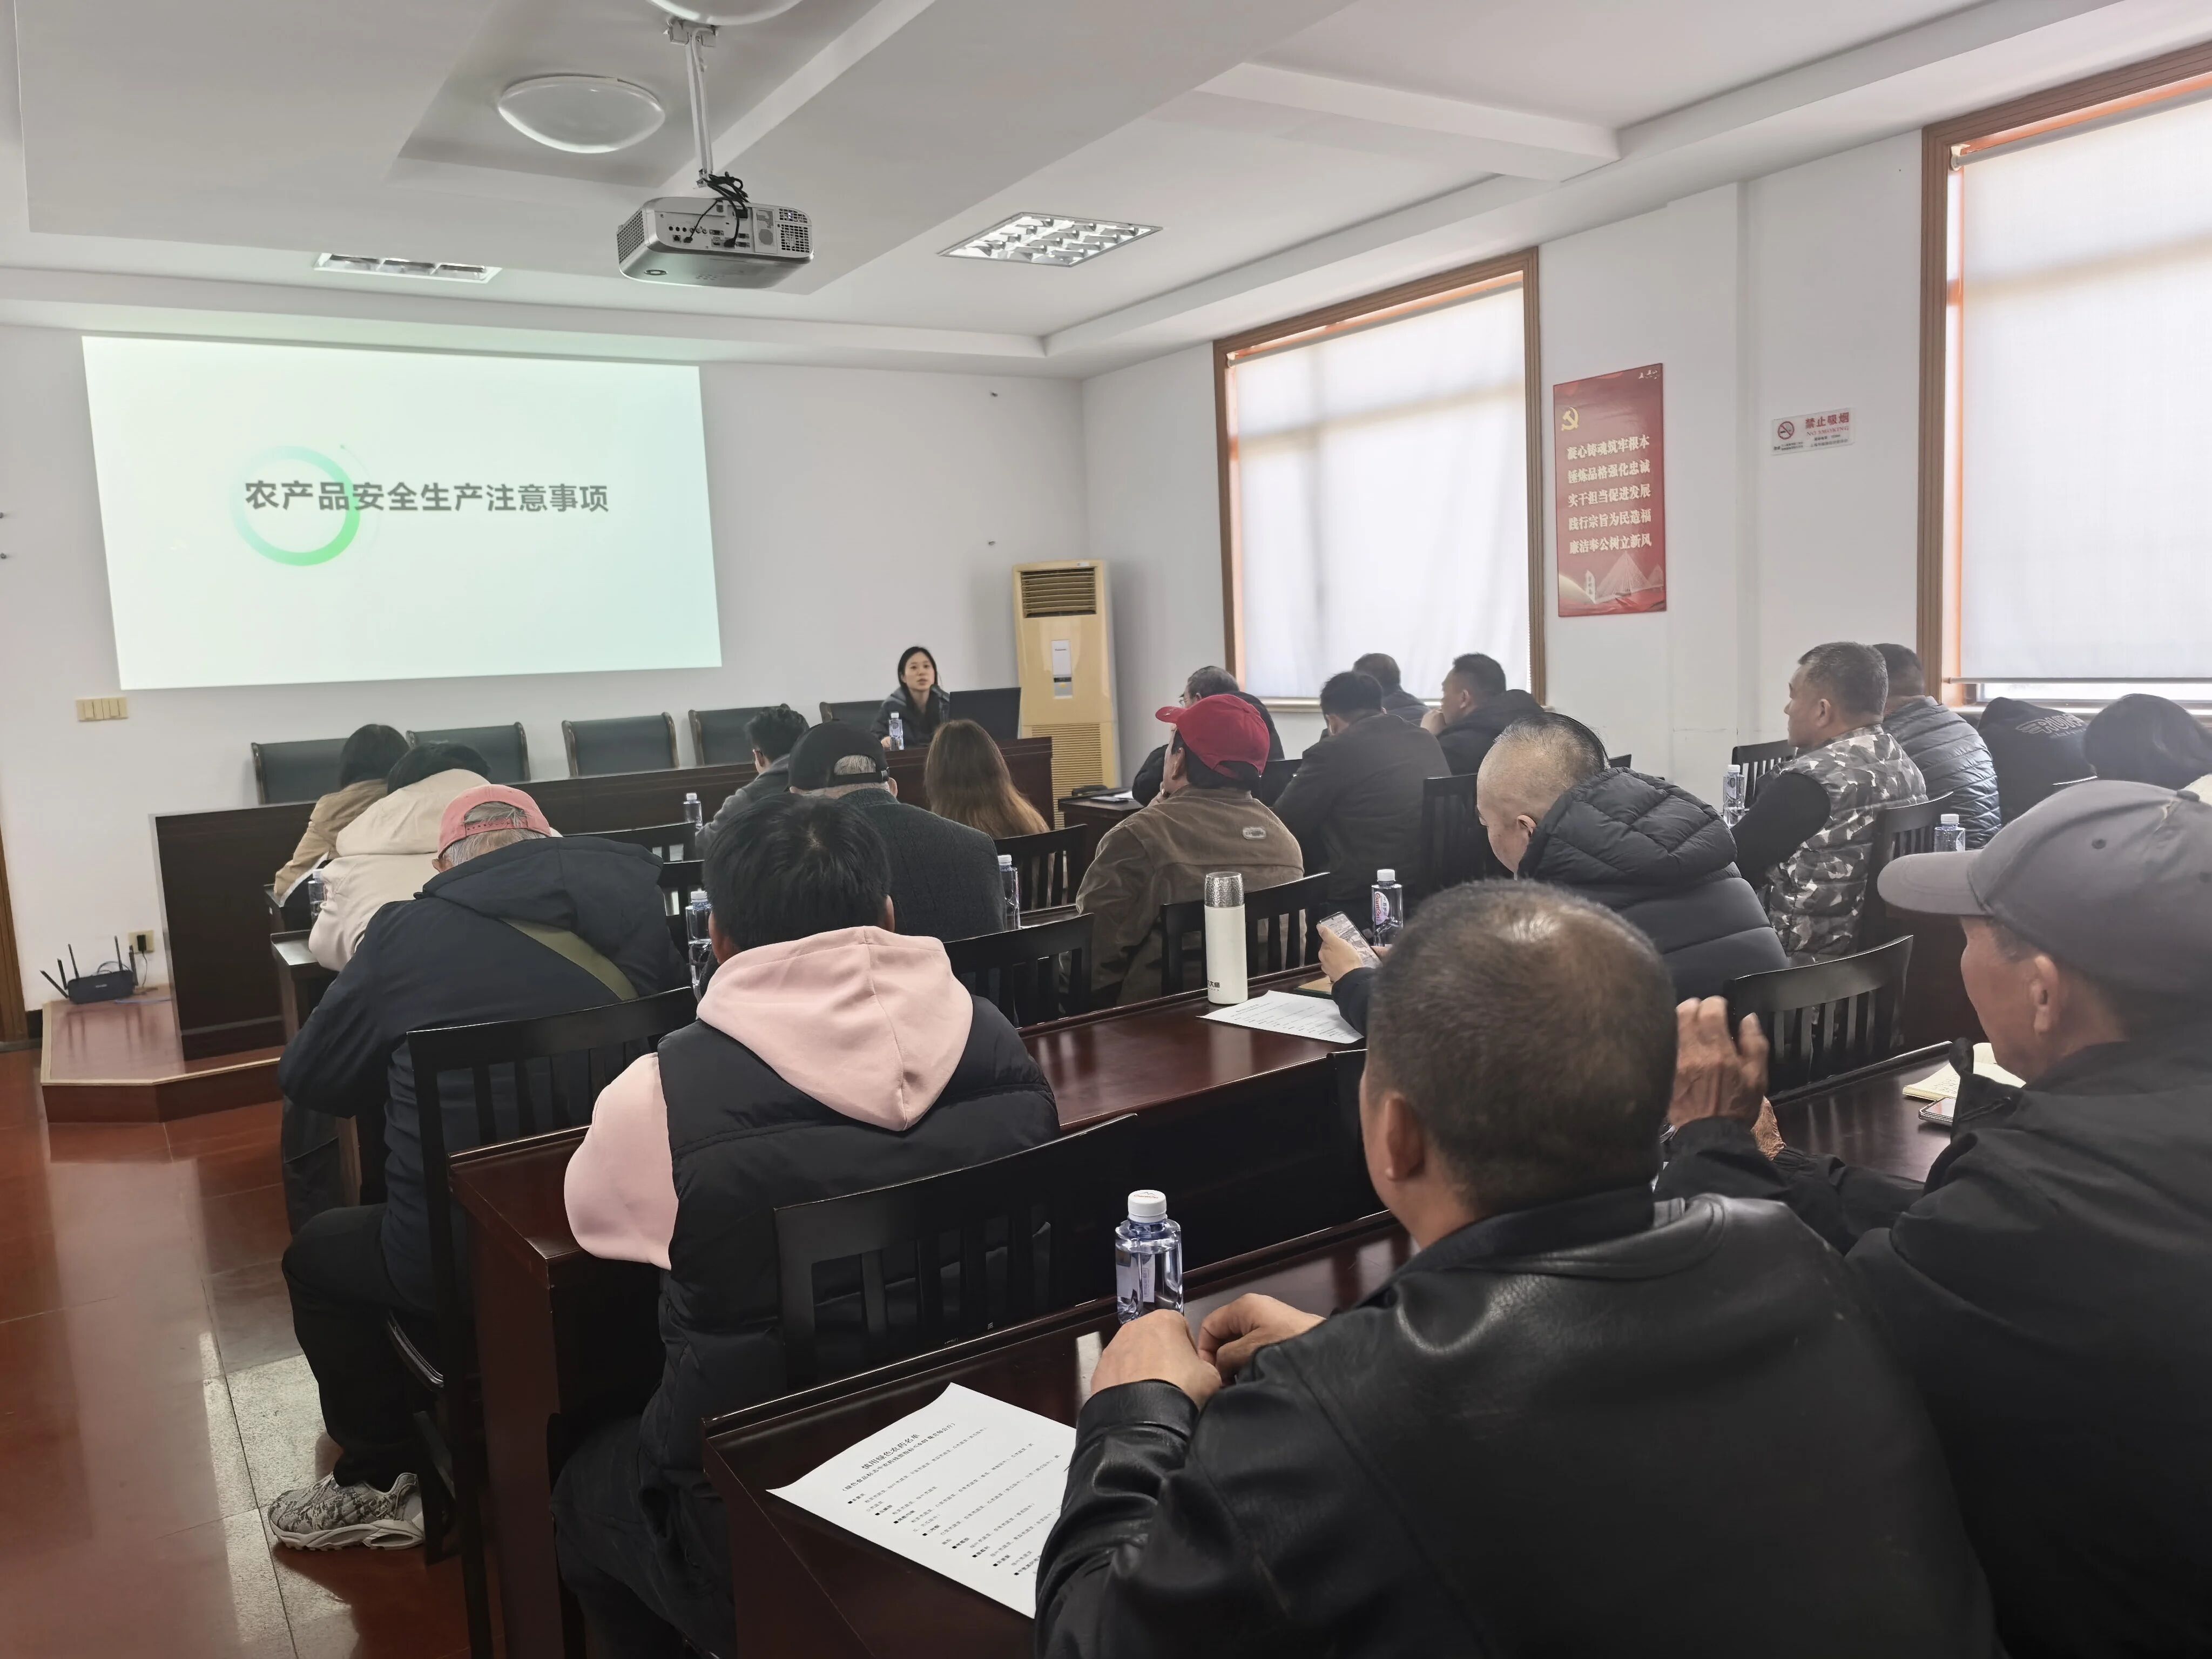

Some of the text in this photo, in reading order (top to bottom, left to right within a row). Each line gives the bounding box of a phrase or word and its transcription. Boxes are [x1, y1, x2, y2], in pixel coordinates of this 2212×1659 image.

[1805, 412, 1849, 429] 禁止吸烟
[1567, 434, 1650, 460] 凝心铸魂筑牢根本
[1568, 458, 1650, 484] 锤炼品格强化忠诚
[245, 480, 609, 512] 农产品安全生产注意事项
[1568, 483, 1651, 507] 实干担当促进发展
[1569, 508, 1651, 531] 践行宗旨为民造福
[1569, 533, 1652, 555] 廉洁奉公树立新风
